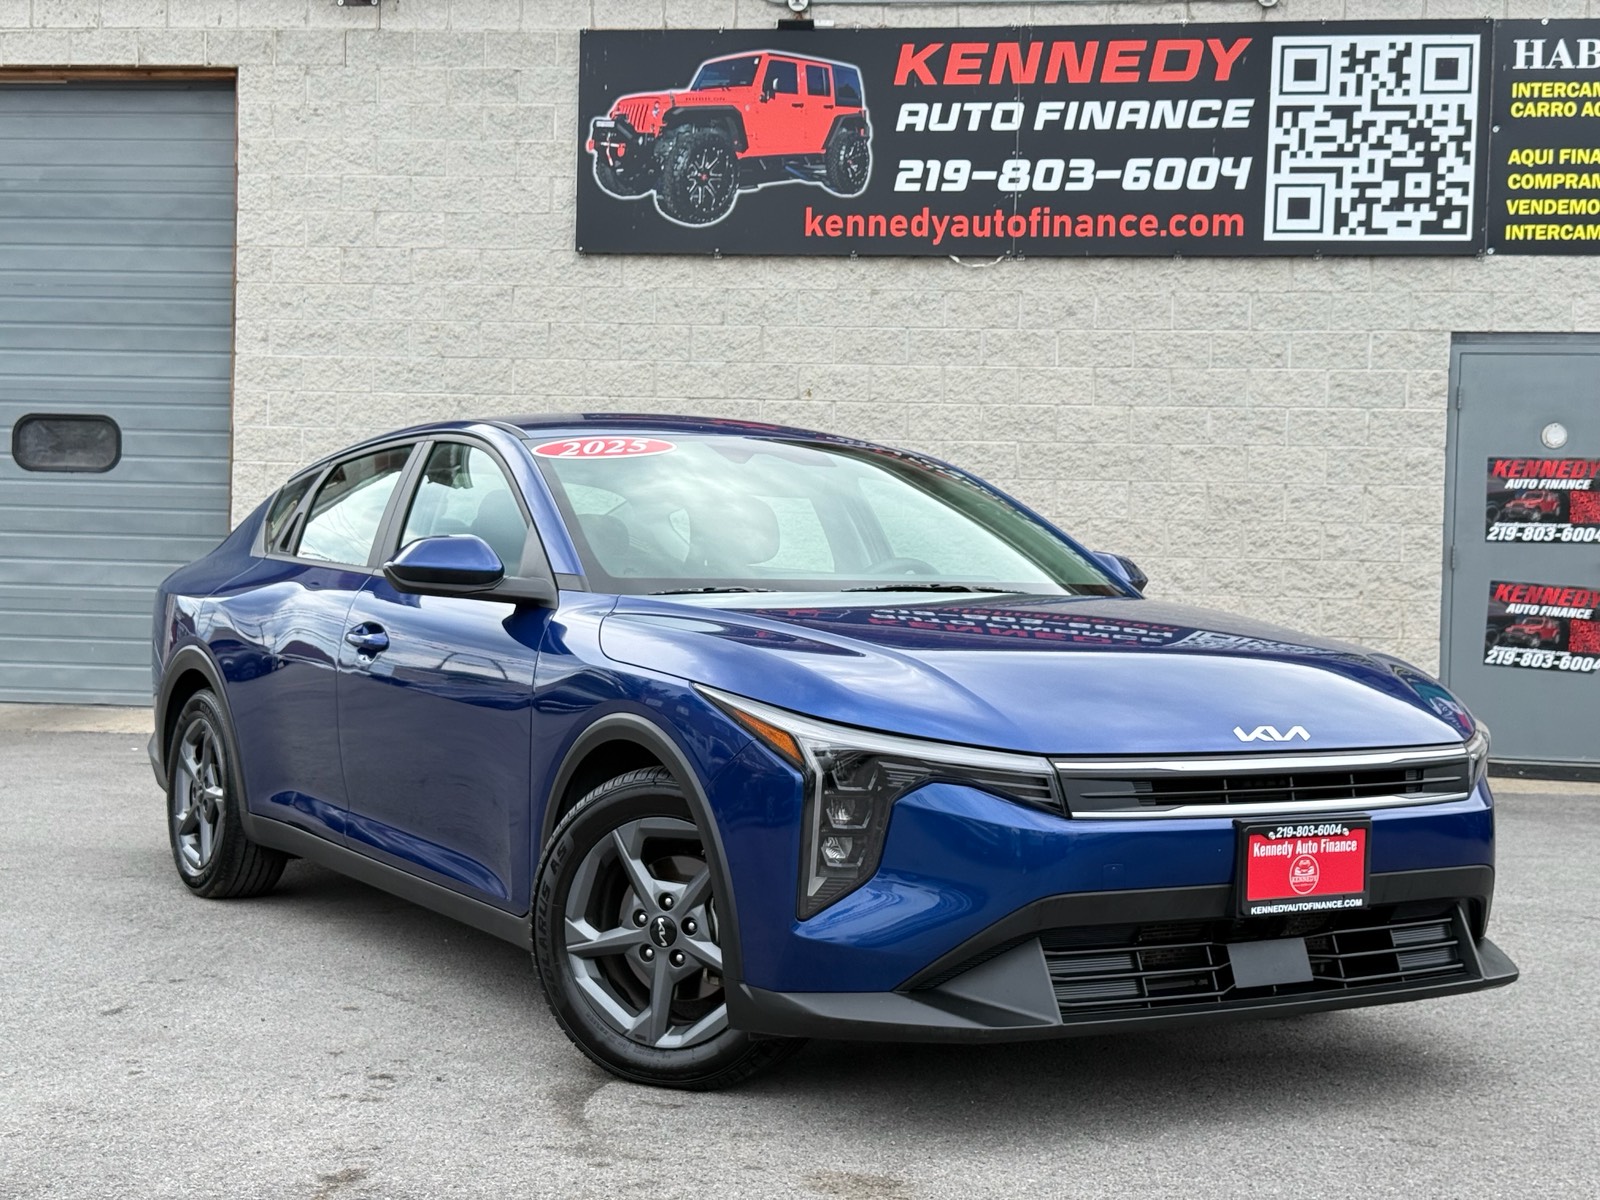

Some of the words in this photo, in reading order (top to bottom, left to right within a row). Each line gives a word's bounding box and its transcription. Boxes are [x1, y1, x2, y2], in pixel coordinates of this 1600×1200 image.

[893, 38, 1253, 86] KENNEDY
[1512, 38, 1600, 69] HAB
[895, 101, 1025, 132] AUTO
[1033, 98, 1255, 131] FINANCE
[1510, 101, 1577, 118] CARRO
[1507, 148, 1554, 167] AQUI
[1559, 148, 1600, 165] FINA
[894, 156, 1253, 192] 219-803-6004
[1506, 199, 1600, 215] VENDEMO
[804, 207, 1244, 245] kennedyautofinance.com
[1505, 224, 1600, 241] INTERCAM
[559, 440, 649, 456] 2025
[1492, 459, 1600, 478] KENNEDY
[1504, 479, 1538, 489] AUTO
[1538, 479, 1593, 490] FINANCE
[1493, 583, 1600, 608] KENNEDY
[1505, 603, 1539, 615] AUTO
[1539, 605, 1594, 620] FINANCE
[1484, 649, 1600, 672] 219-803-6004
[1233, 726, 1311, 742] KIA
[1276, 824, 1342, 838] 219-803-6004
[1253, 841, 1293, 858] Kennedy
[1296, 840, 1318, 854] Auto
[1320, 838, 1358, 853] Finance
[1251, 899, 1363, 915] KENNEDYAUTOFINANCE.COM
